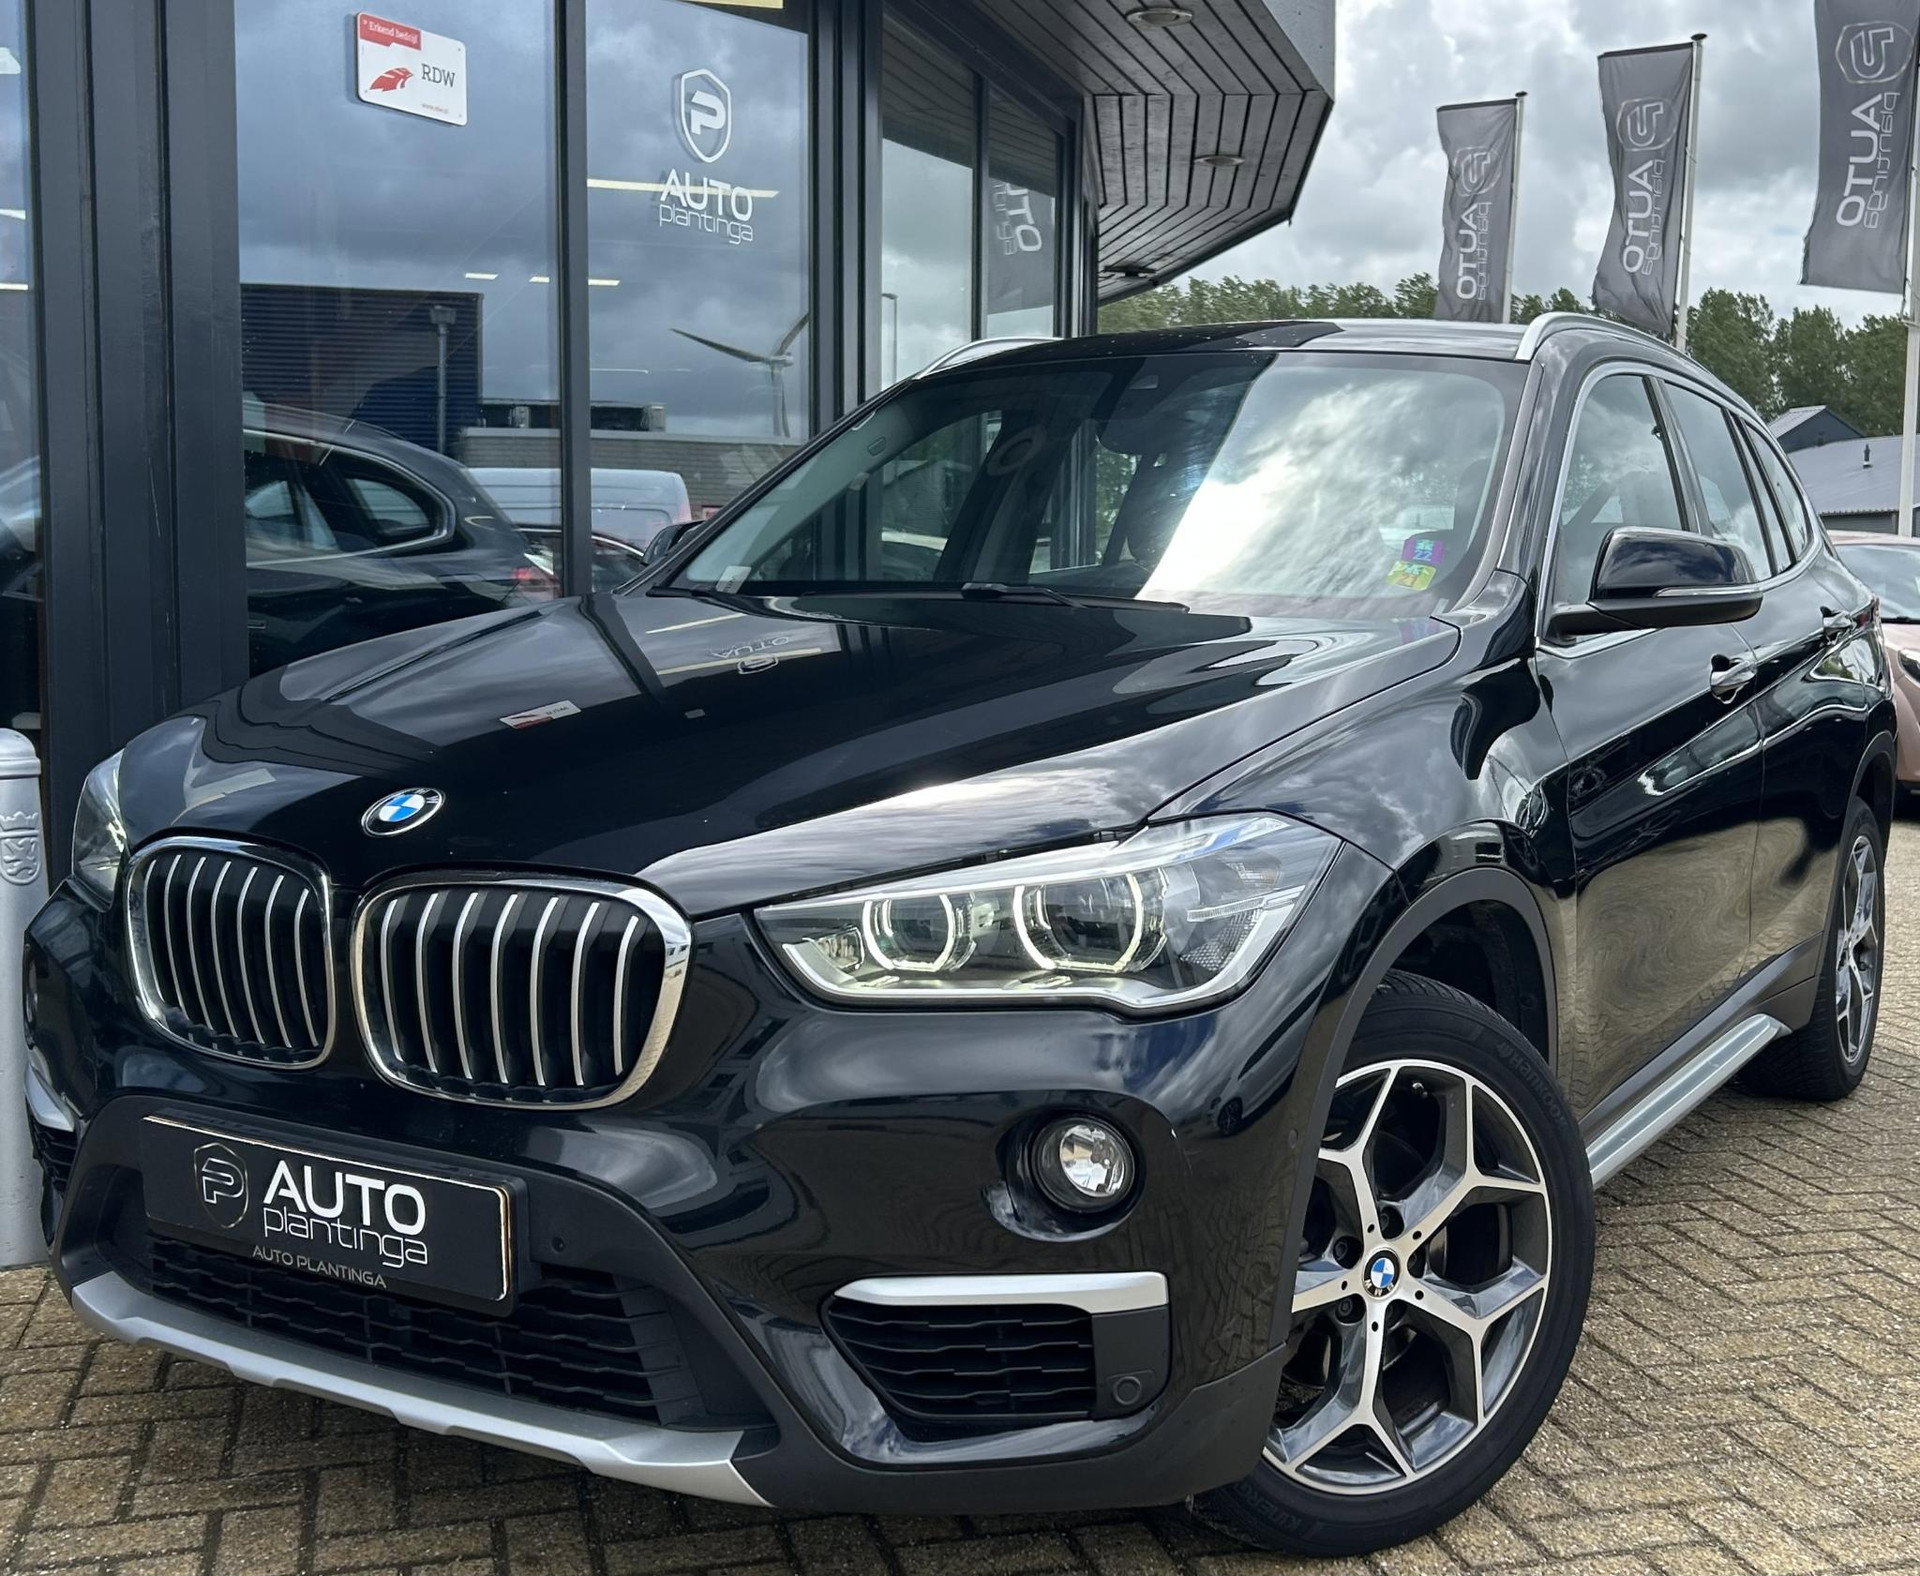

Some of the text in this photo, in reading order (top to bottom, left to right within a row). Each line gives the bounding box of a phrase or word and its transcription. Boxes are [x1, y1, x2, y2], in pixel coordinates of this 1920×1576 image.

[421, 63, 456, 88] RDW
[660, 168, 753, 222] AUTO
[659, 204, 753, 245] plantinga
[263, 1160, 426, 1235] AUTO
[263, 1206, 428, 1268] plantinga
[252, 1245, 387, 1289] AUTO PLANTINGA
